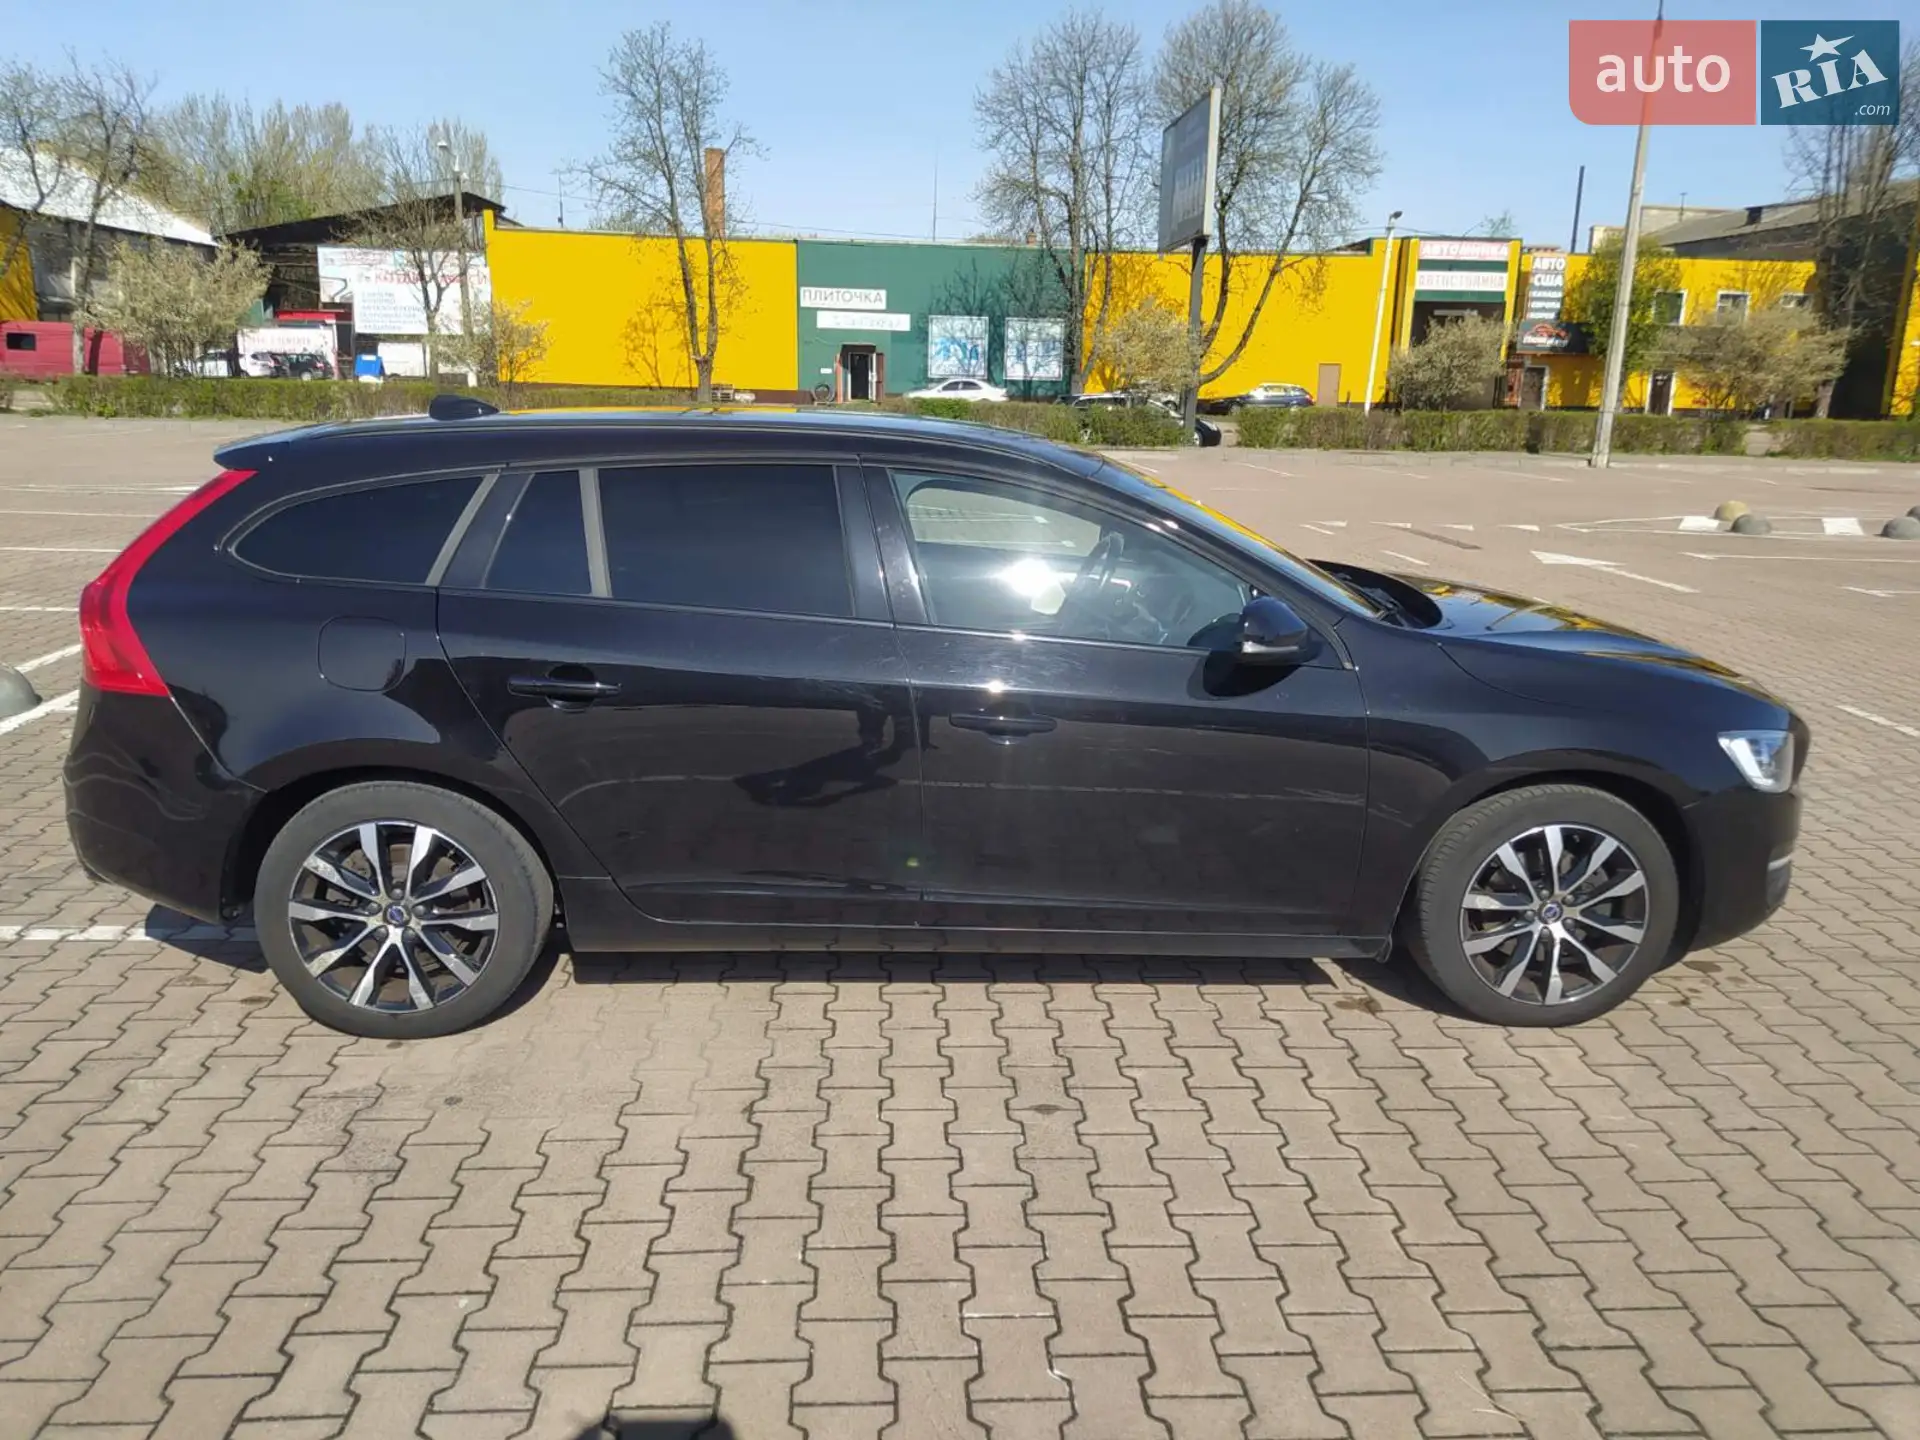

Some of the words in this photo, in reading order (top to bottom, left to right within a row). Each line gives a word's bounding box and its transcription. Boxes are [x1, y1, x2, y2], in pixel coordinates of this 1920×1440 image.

[1532, 256, 1566, 271] АВТО
[1533, 273, 1564, 287] США
[802, 288, 884, 304] ПЛИТОЧКА
